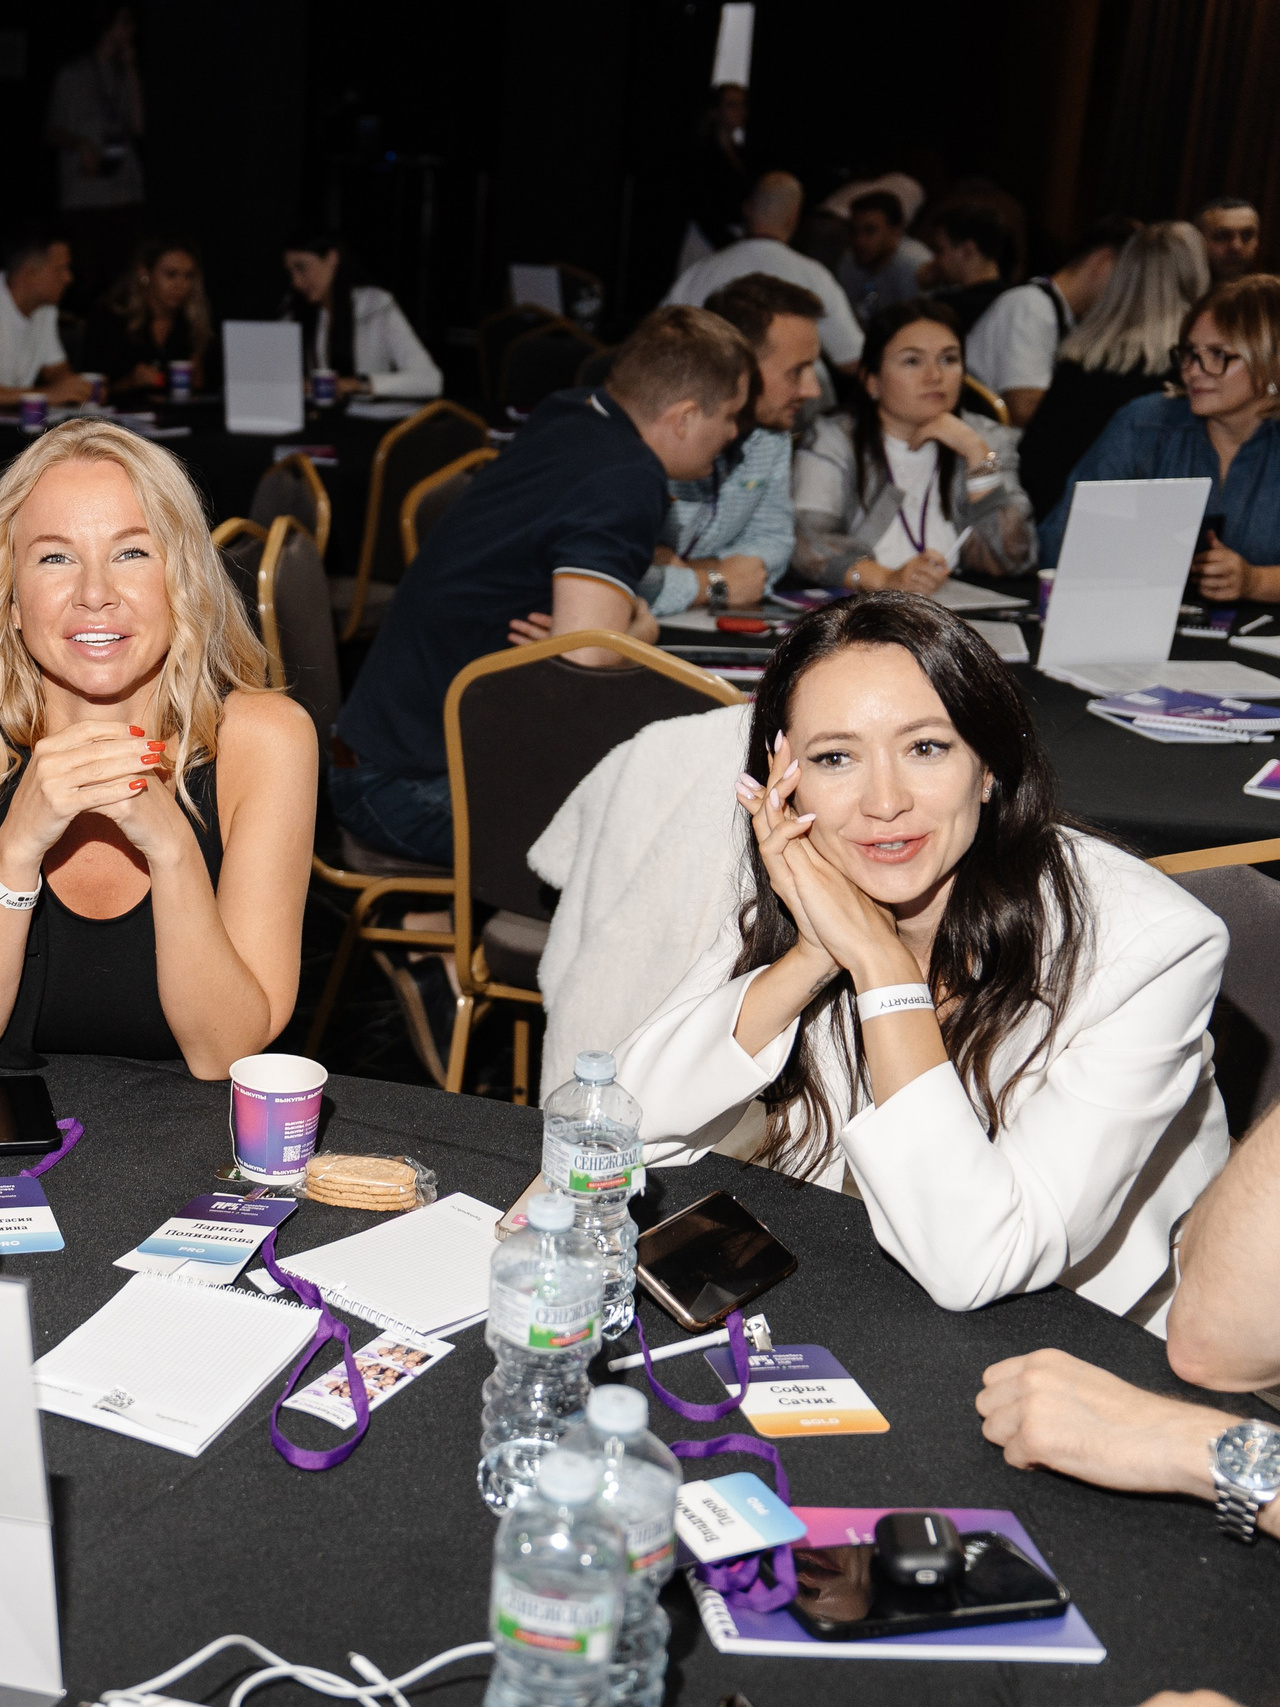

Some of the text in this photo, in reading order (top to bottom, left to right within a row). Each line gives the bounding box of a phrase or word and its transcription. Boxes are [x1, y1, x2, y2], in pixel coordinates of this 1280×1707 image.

[240, 1088, 267, 1100] ВЫКУПЫ
[275, 1095, 306, 1103] ВЫКУПЫ
[574, 1148, 638, 1170] СЕНЕЖСКАЯ
[190, 1222, 245, 1234] Лариса
[164, 1229, 255, 1245] Поливанова
[177, 1246, 206, 1254] PRO
[770, 1384, 827, 1395] Софья
[778, 1396, 836, 1406] Сачик
[799, 1417, 840, 1426] GOLD
[702, 1497, 736, 1527] Перов
